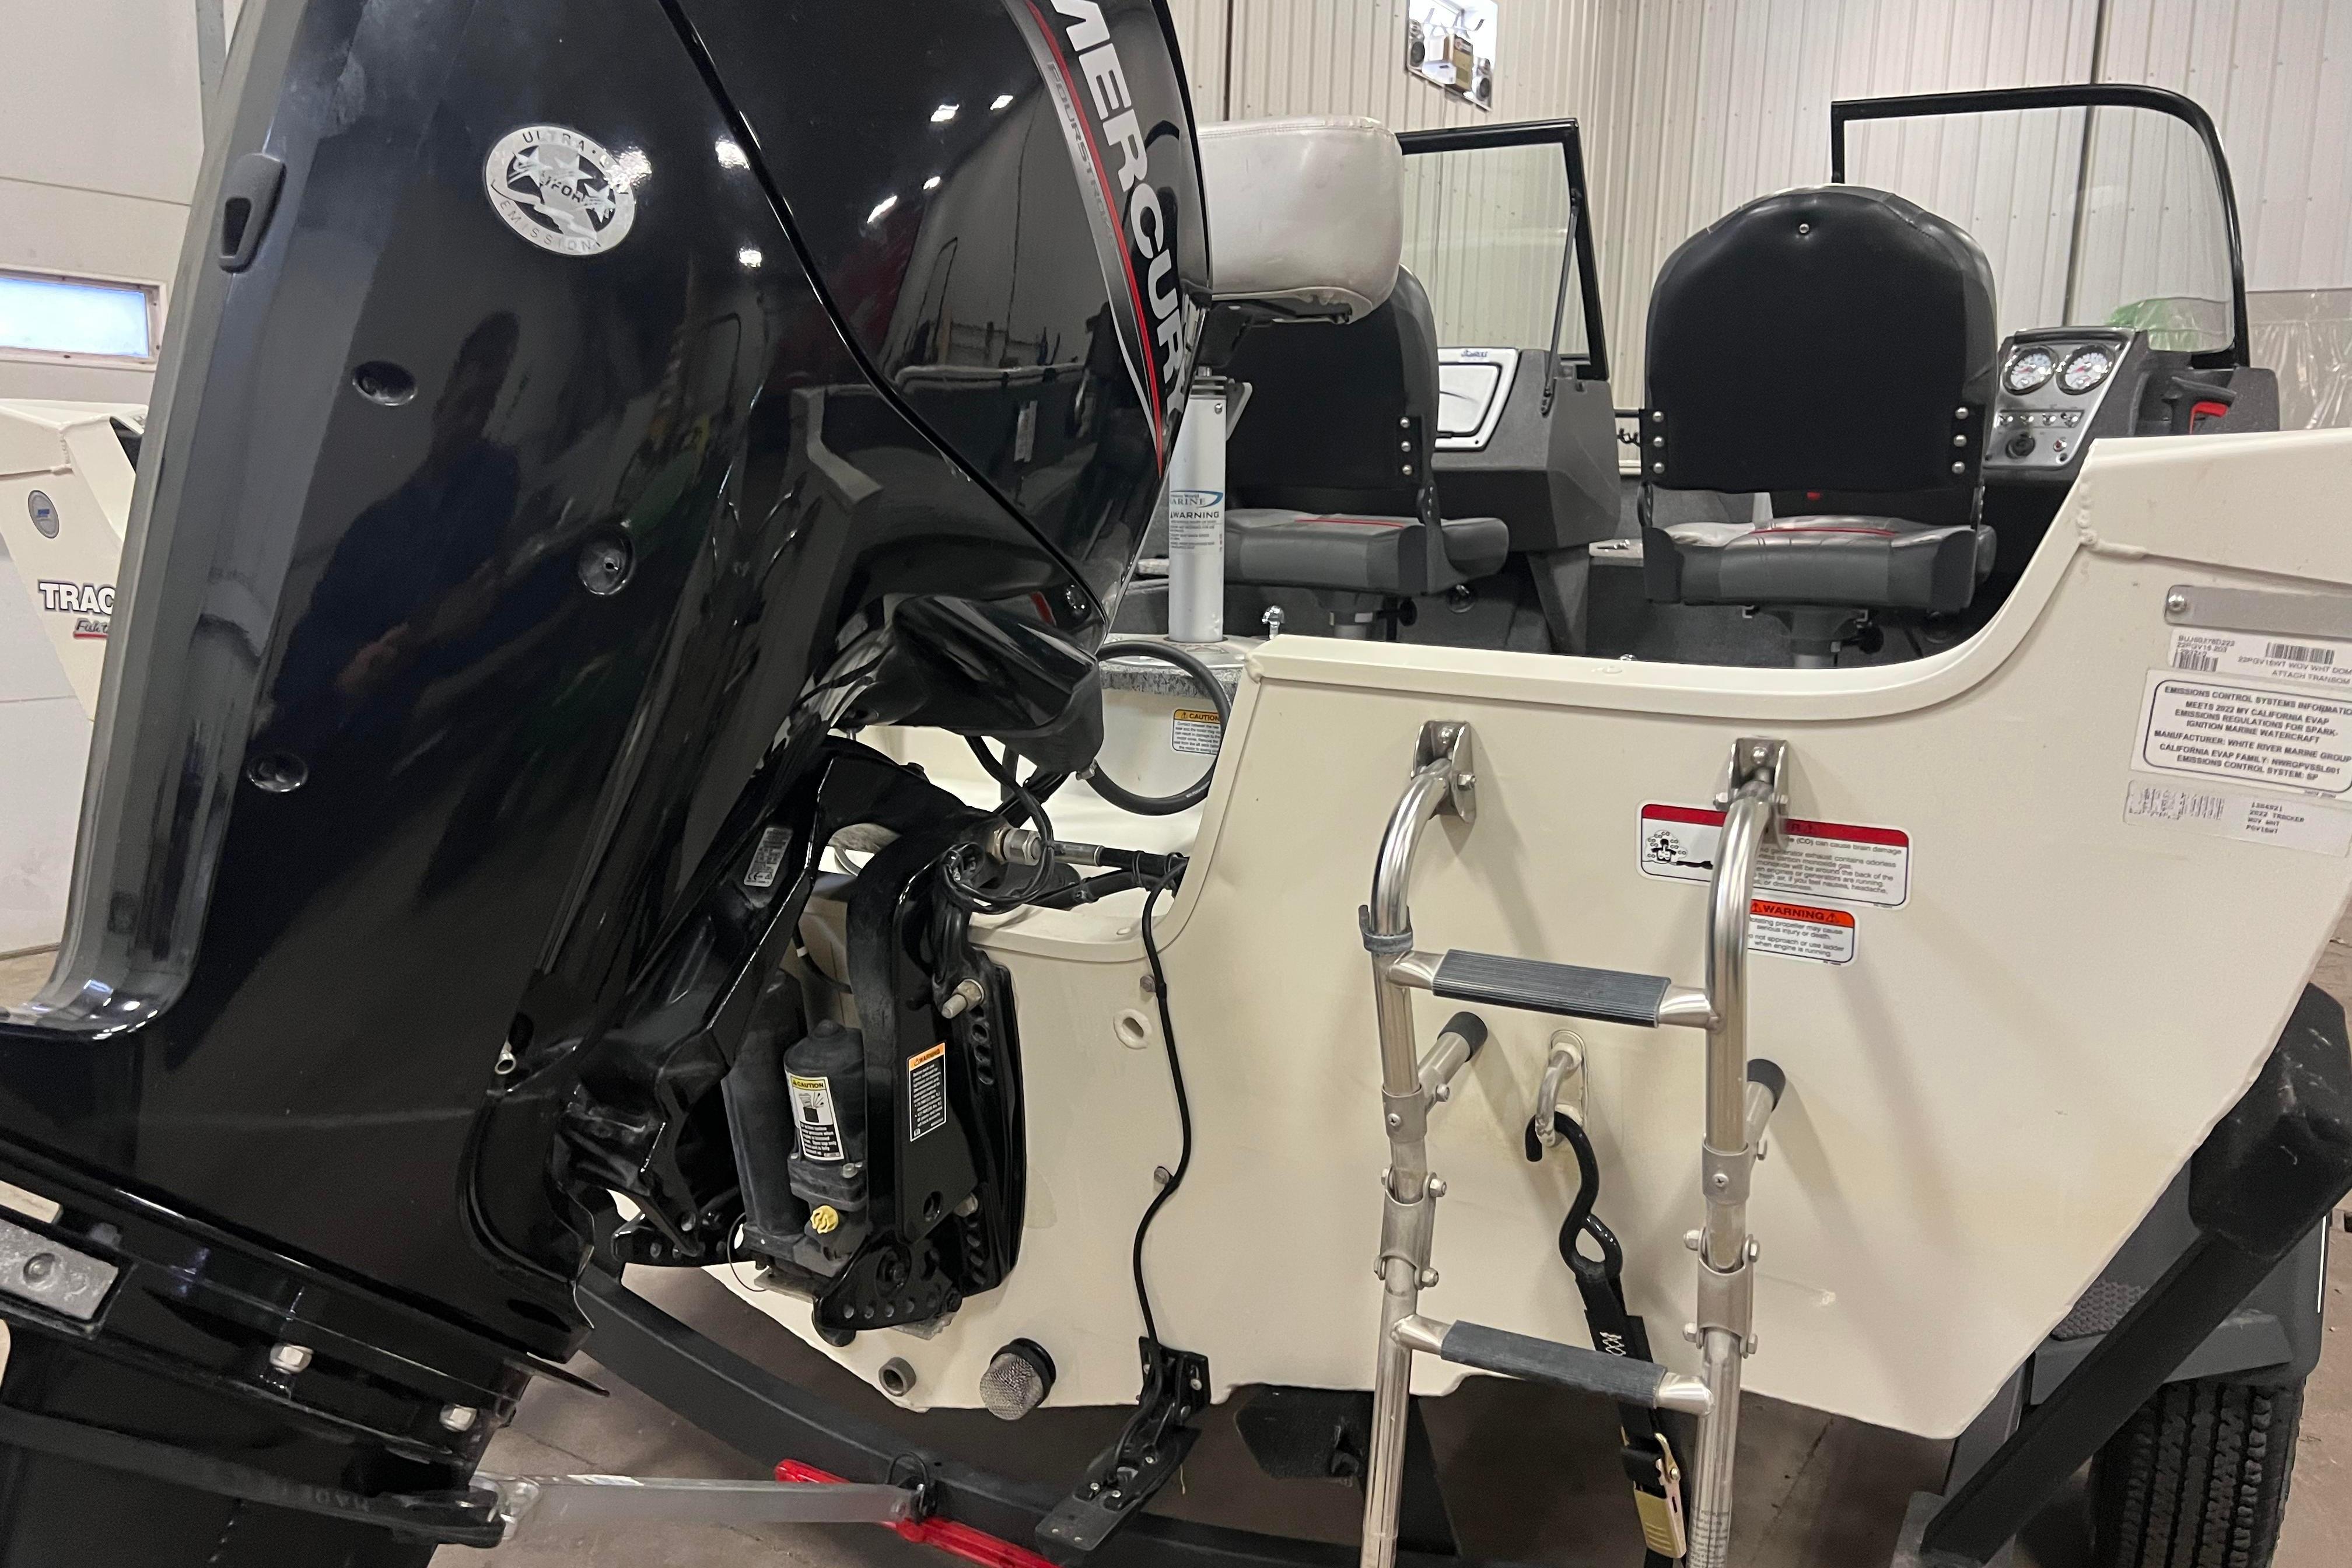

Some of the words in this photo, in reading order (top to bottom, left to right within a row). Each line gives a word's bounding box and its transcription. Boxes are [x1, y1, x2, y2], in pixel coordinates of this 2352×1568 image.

[39, 582, 115, 615] TRAC
[2308, 674, 2350, 684] TRANSOM
[2164, 686, 2210, 698] EMISSIONS
[2211, 691, 2253, 703] CONTROL
[2255, 696, 2295, 708] SYSTEMS
[2298, 702, 2352, 716] INFORMATIO
[2175, 709, 2220, 720] EMISSIONS
[2222, 715, 2283, 729] REGULATIONS
[2285, 722, 2304, 732] FOR
[2186, 701, 2213, 710] MEETS
[2251, 709, 2301, 721] CALIFORNIA
[2305, 716, 2329, 725] EVAP
[2186, 720, 2222, 730] IGNITION
[2225, 724, 2257, 735] MARINE
[2259, 729, 2319, 743] WATERCRAFT
[2159, 743, 2209, 755] CALIFORNIA
[2211, 750, 2234, 759] EVAP
[2227, 738, 2254, 749] WHITE
[2256, 743, 2282, 752] RIVER
[2284, 747, 2318, 758] MARINE
[2320, 752, 2351, 763] GROUP
[2176, 754, 2222, 766] EMISSIONS
[2224, 761, 2264, 773] CONTROL
[1796, 837, 1813, 846] (CO)
[1852, 844, 1871, 852] brain
[1872, 846, 1902, 855] damage
[1749, 916, 1774, 926] otating
[1762, 905, 1824, 920] WARNING
[1782, 928, 1800, 936] injury
[1767, 936, 1798, 945] approach
[1822, 943, 1844, 951] ladder
[1773, 943, 1796, 951] engine
